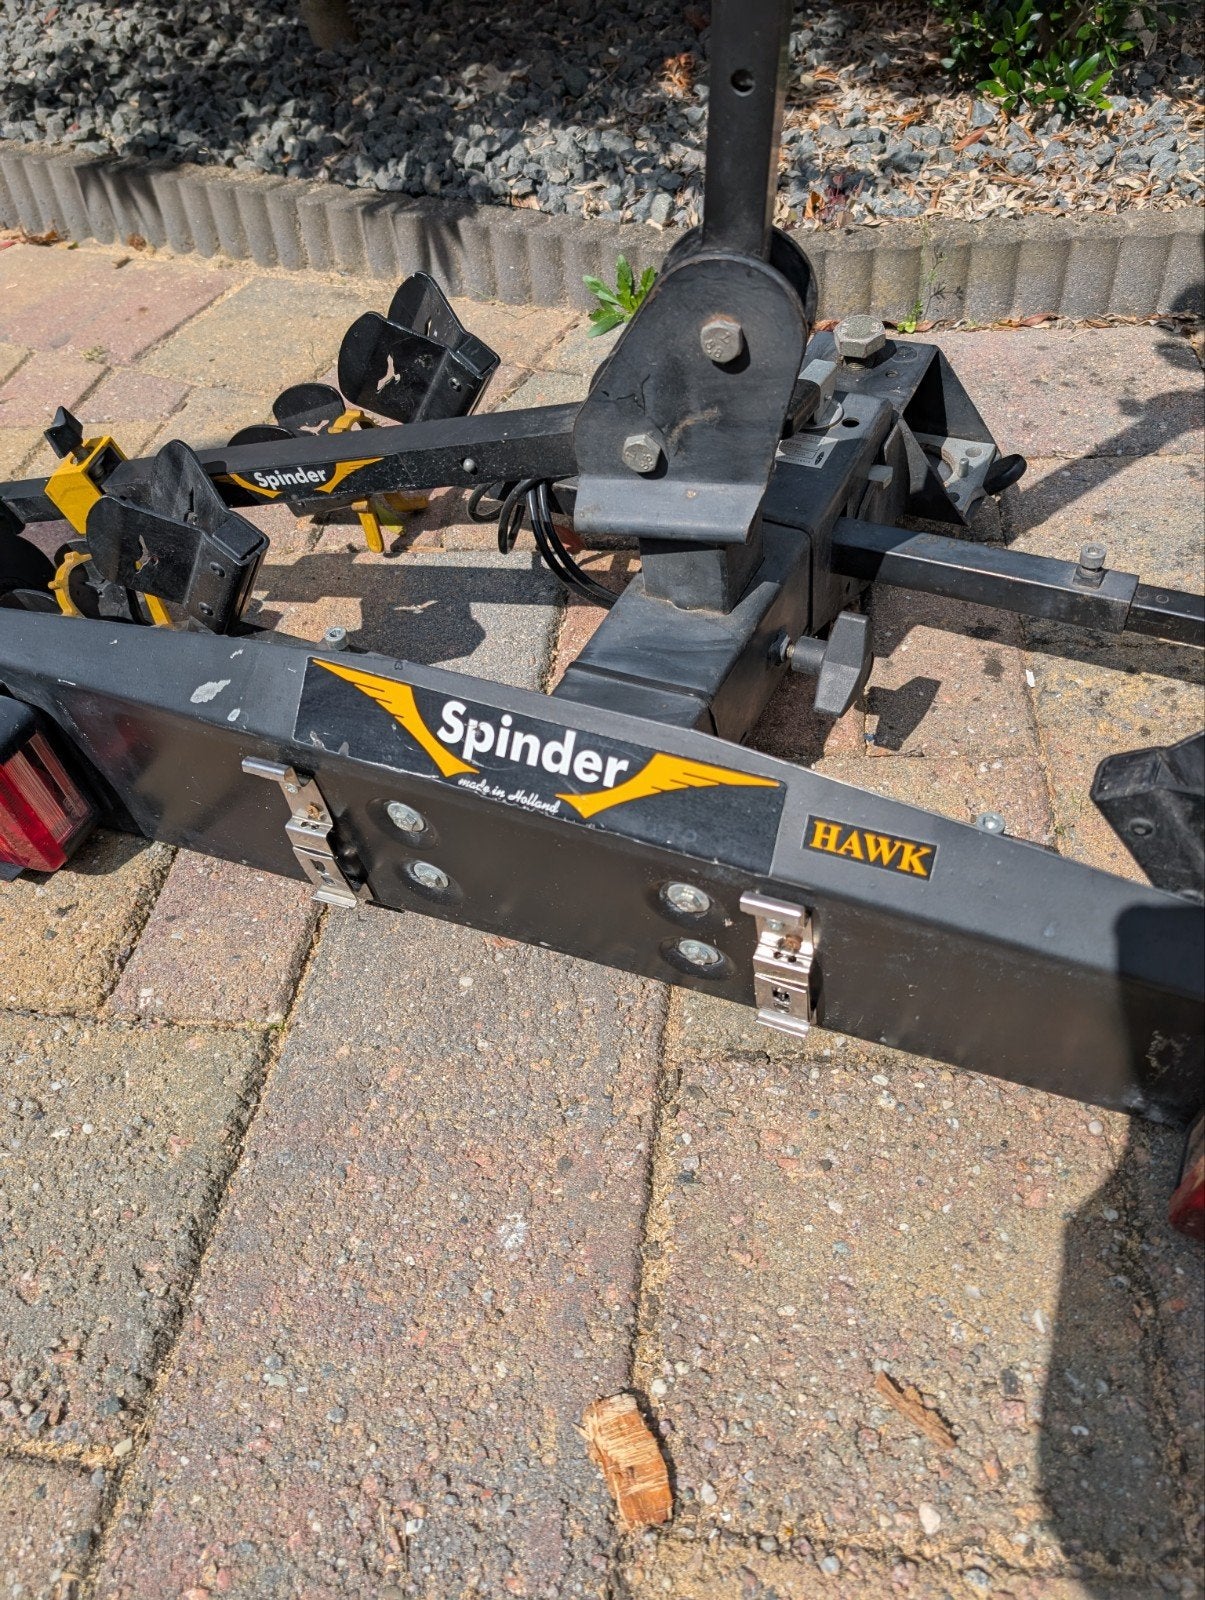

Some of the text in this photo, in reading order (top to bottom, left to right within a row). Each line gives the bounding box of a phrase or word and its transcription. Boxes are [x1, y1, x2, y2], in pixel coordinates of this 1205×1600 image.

[253, 467, 326, 490] Spinder
[437, 700, 629, 788] Spinder
[457, 778, 561, 813] made in Holland
[809, 821, 932, 876] HAWK
